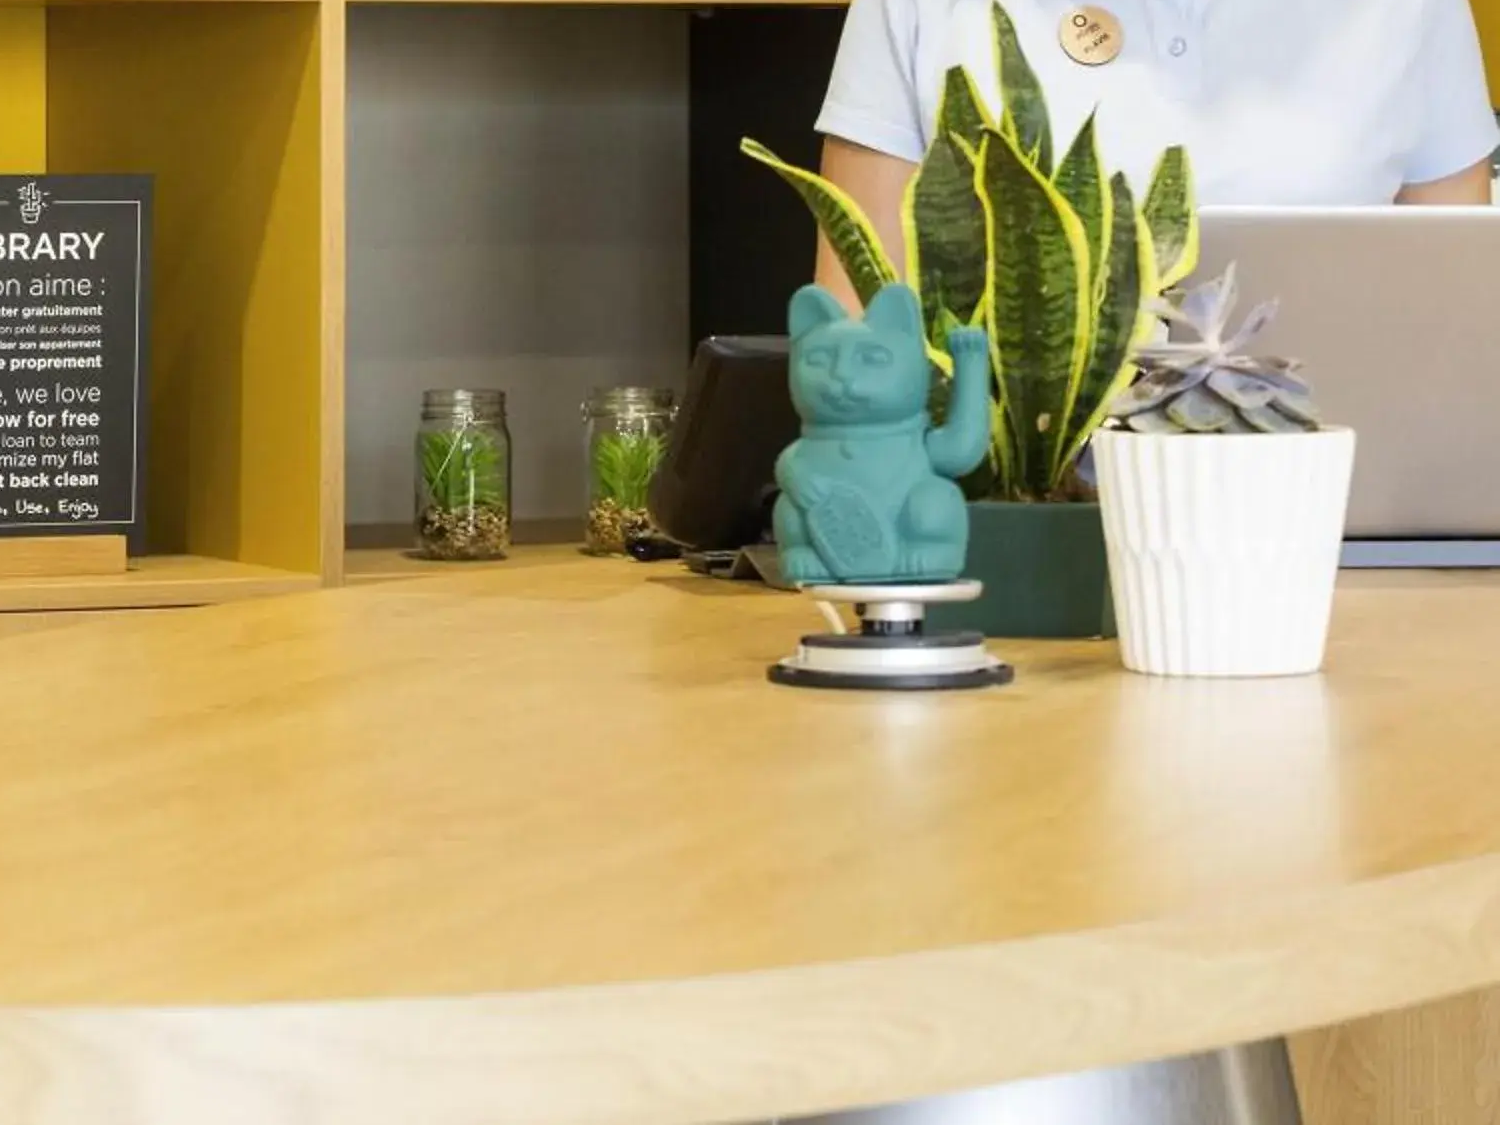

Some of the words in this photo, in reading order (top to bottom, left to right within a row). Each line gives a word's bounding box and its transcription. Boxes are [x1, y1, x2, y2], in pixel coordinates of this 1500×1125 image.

[29, 273, 92, 297] aime
[21, 305, 103, 319] gratuitement
[39, 325, 59, 334] aux
[60, 323, 102, 335] équipes
[18, 342, 37, 350] son
[39, 339, 102, 350] appartement
[9, 355, 103, 372] proprement
[16, 388, 48, 404] we
[55, 382, 101, 403] love
[27, 410, 56, 428] for
[61, 409, 100, 427] free
[1, 434, 34, 448] loan
[40, 434, 56, 448] to
[61, 434, 99, 447] team
[41, 454, 67, 469] my
[72, 450, 99, 466] flat
[9, 472, 50, 488] back
[54, 471, 99, 487] clean
[58, 498, 99, 520] Enjoy
